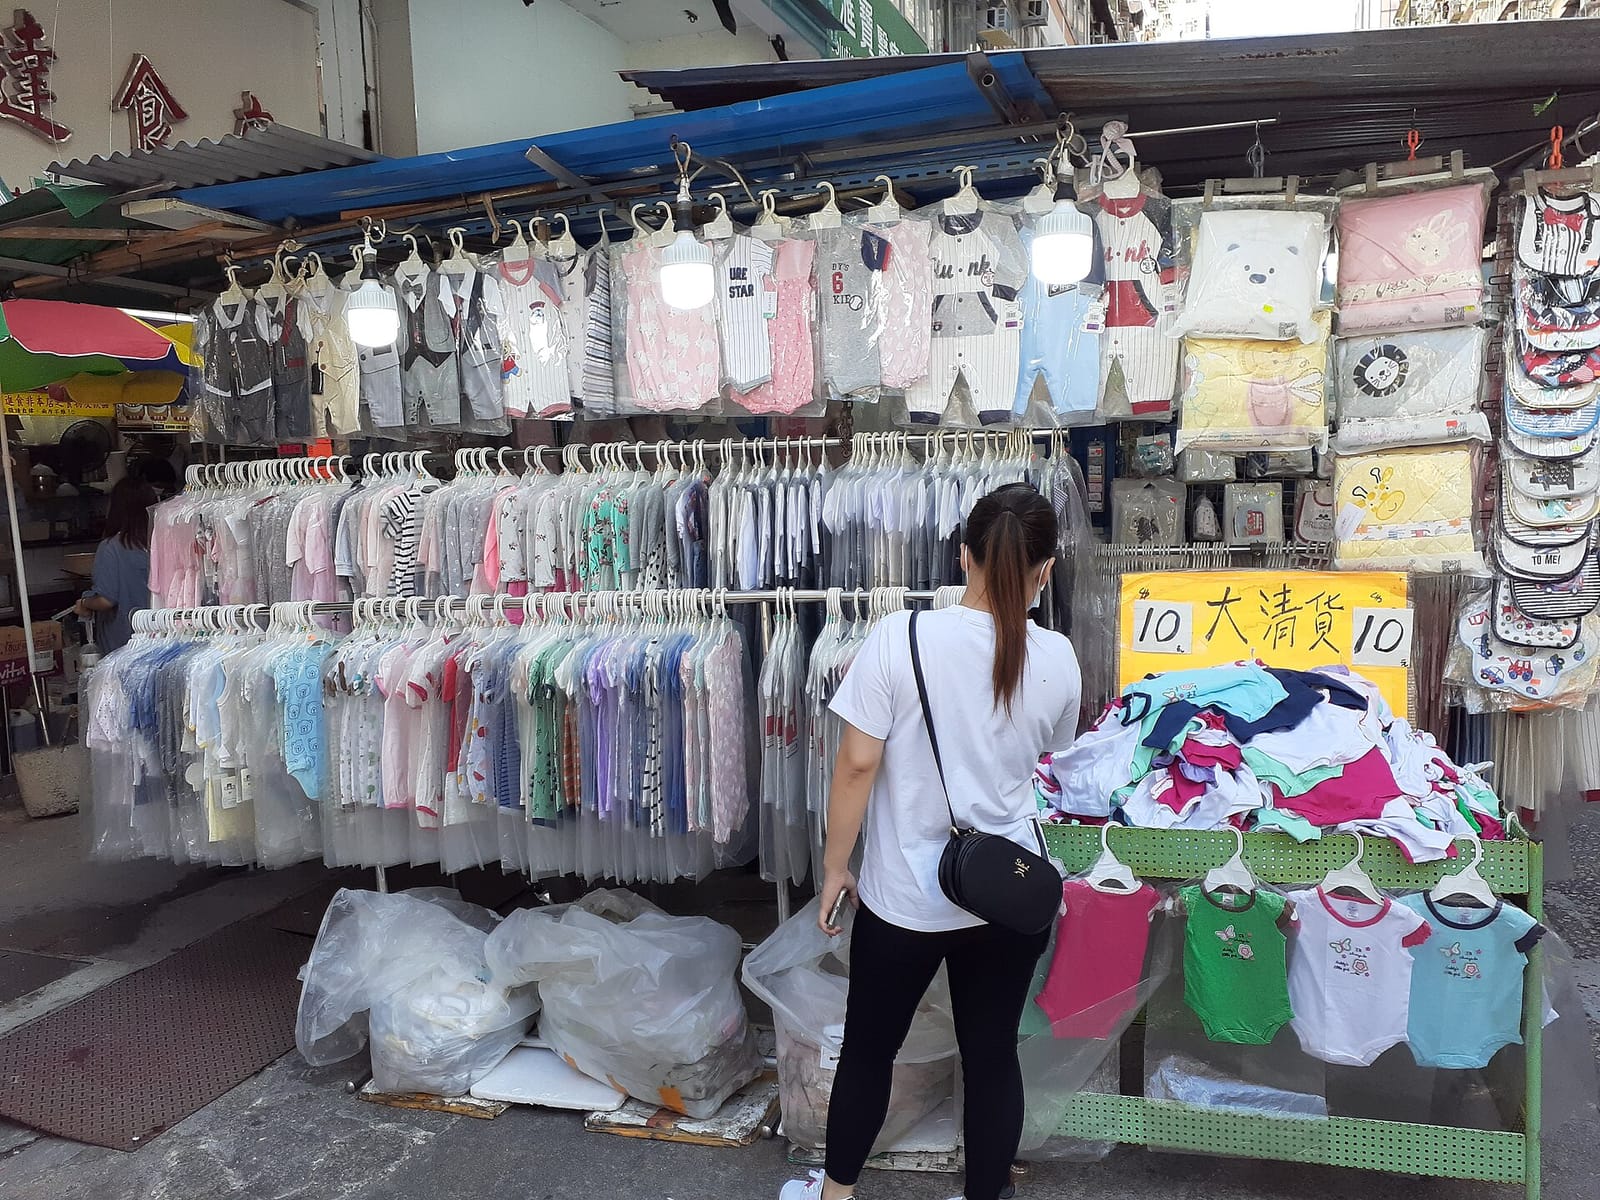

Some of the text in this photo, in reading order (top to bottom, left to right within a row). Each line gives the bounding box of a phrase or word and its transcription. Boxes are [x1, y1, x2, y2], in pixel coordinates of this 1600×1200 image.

[728, 284, 755, 299] STAR
[831, 271, 844, 294] 6
[1531, 554, 1561, 566] TO ME!
[1139, 607, 1181, 642] 10
[1205, 583, 1345, 653] 大清貨
[1353, 615, 1404, 654] 10
